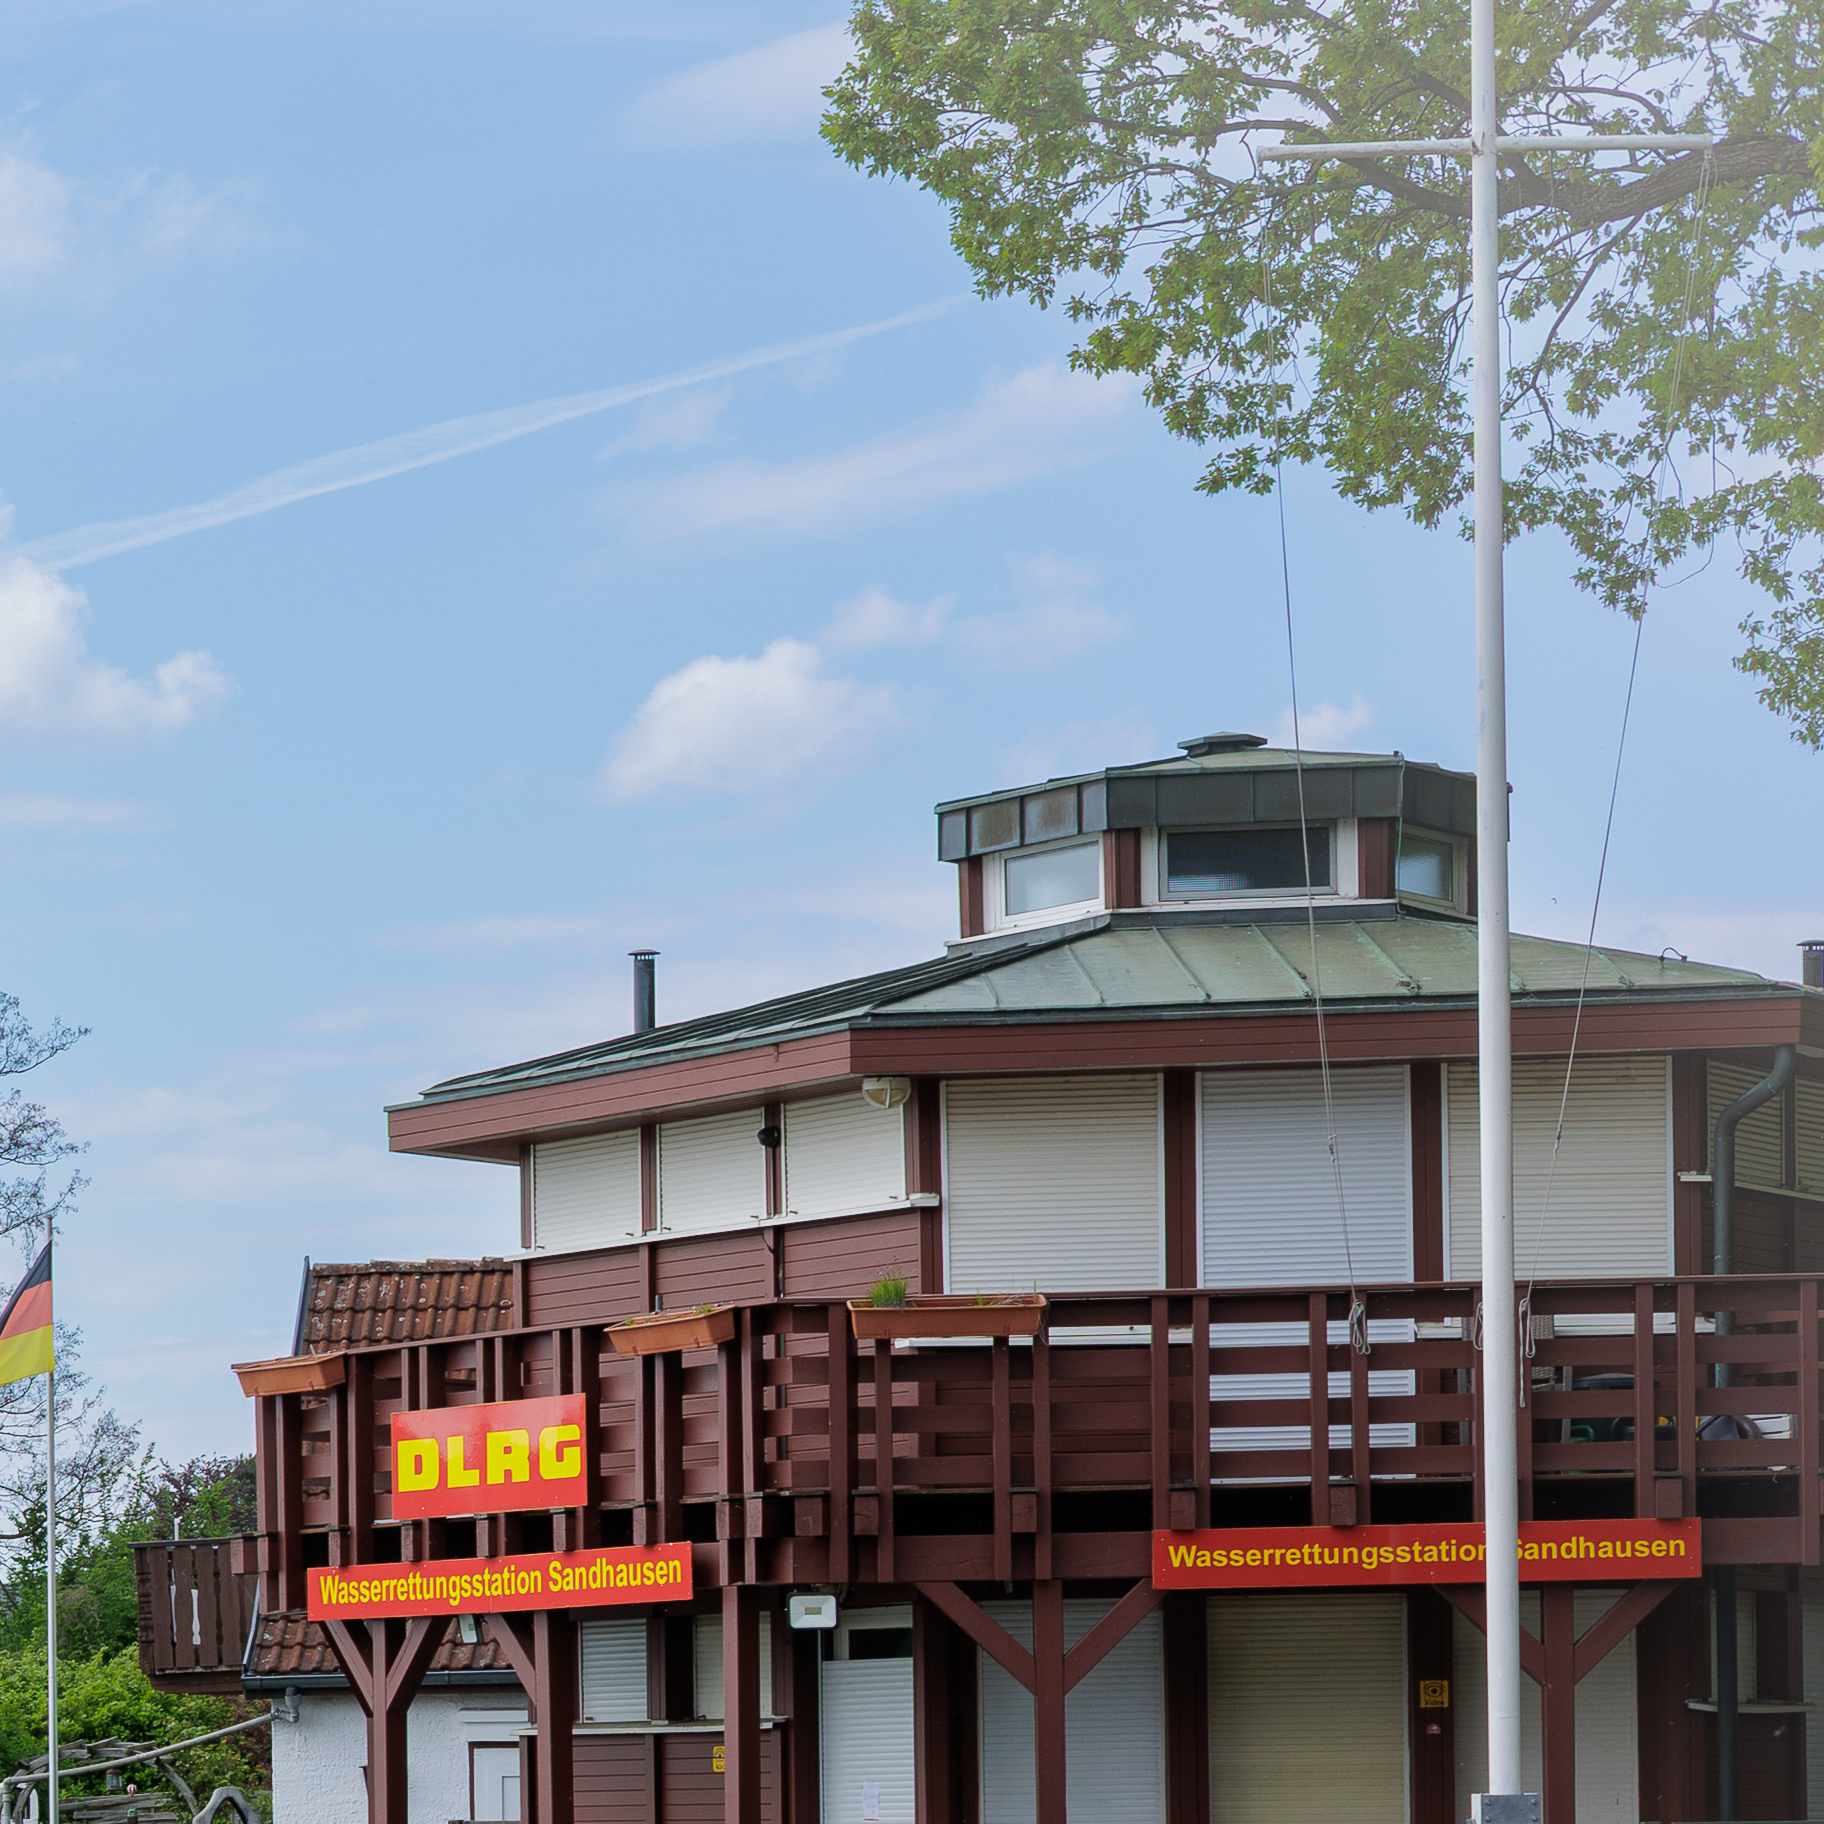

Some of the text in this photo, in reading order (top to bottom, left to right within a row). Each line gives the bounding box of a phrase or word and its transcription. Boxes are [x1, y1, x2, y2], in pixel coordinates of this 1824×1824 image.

[397, 1424, 582, 1492] DLRG
[319, 1557, 682, 1606] Wasserrettungsstation Sandhausen
